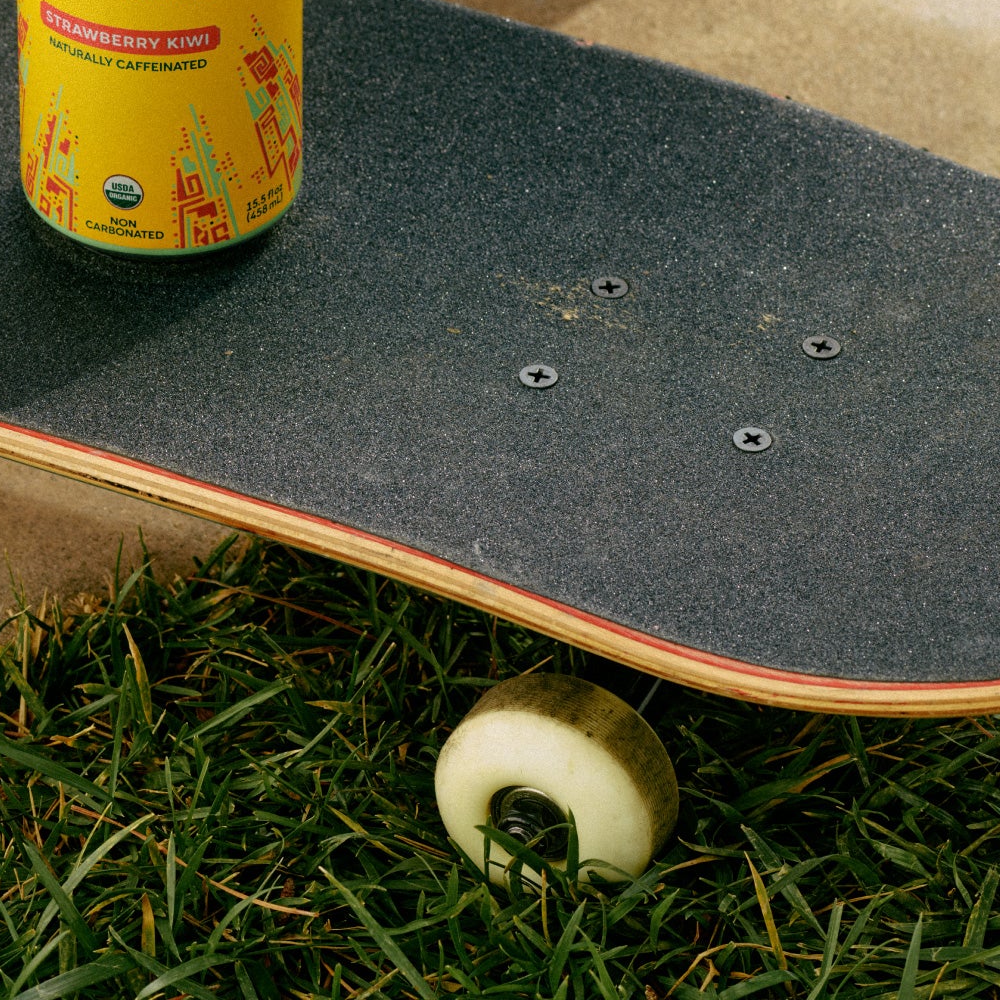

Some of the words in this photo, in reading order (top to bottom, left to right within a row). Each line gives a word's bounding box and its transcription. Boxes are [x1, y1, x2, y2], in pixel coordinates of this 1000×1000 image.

[45, 10, 160, 49] STRAWBERRY
[166, 33, 211, 50] KIWI
[48, 35, 113, 67] NATURALLY
[116, 57, 208, 72] CAFFEINATED
[109, 192, 138, 202] ORGANIC
[111, 182, 135, 193] USDA
[246, 194, 266, 212] 15.5
[246, 204, 268, 223] (458
[269, 191, 283, 210] mL)
[85, 220, 165, 240] CARBONATED
[110, 216, 137, 228] NON
